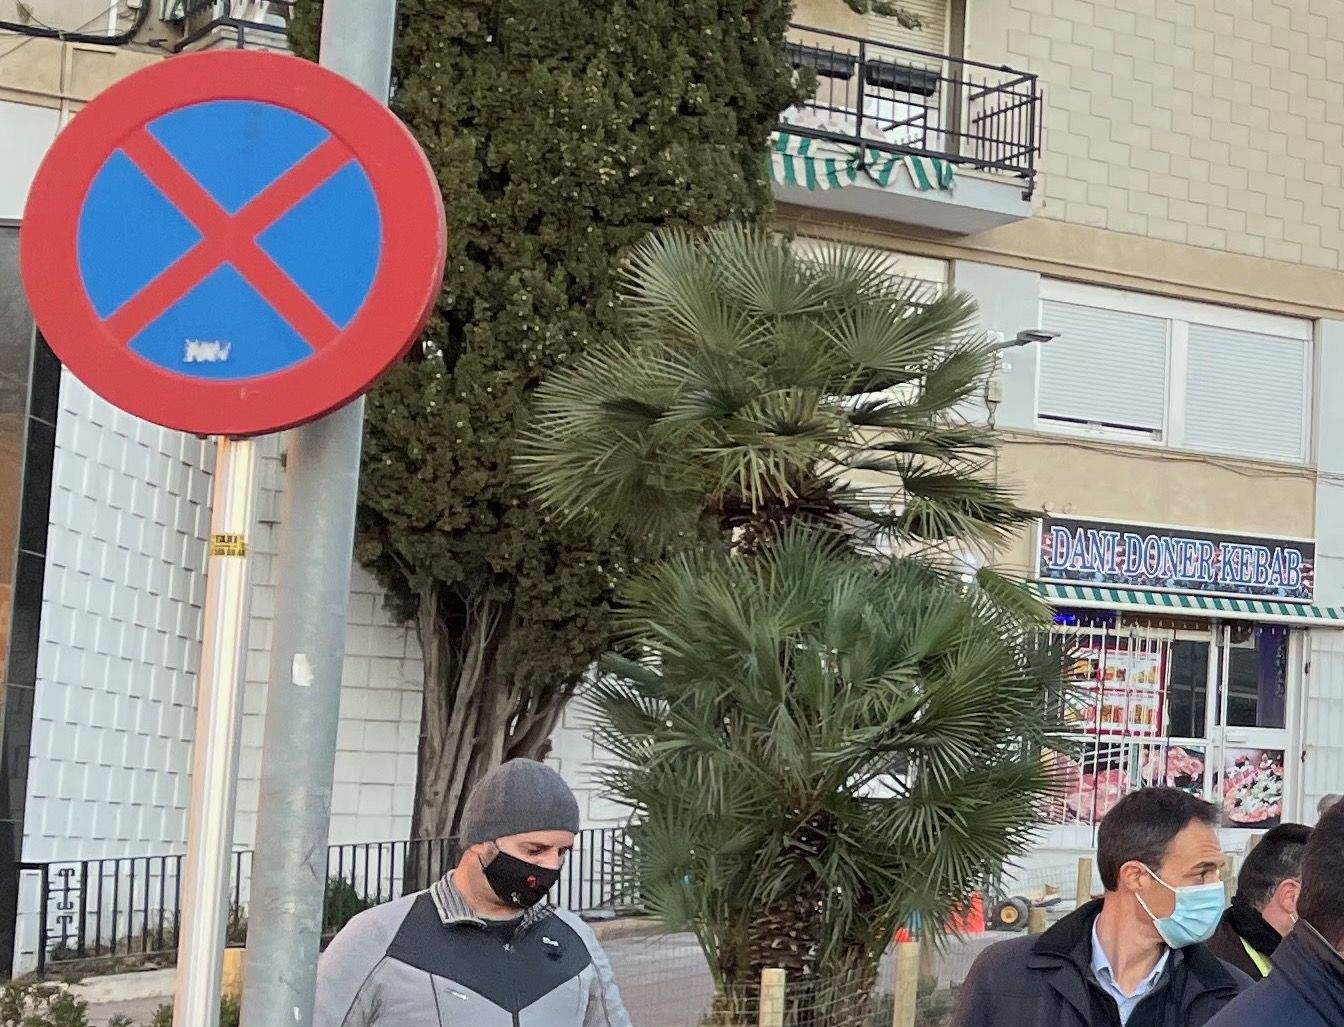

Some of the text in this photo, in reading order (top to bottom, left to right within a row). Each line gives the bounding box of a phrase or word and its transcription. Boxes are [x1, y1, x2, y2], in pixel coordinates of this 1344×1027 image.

[1050, 526, 1302, 589] DANI DONER KEBAB
